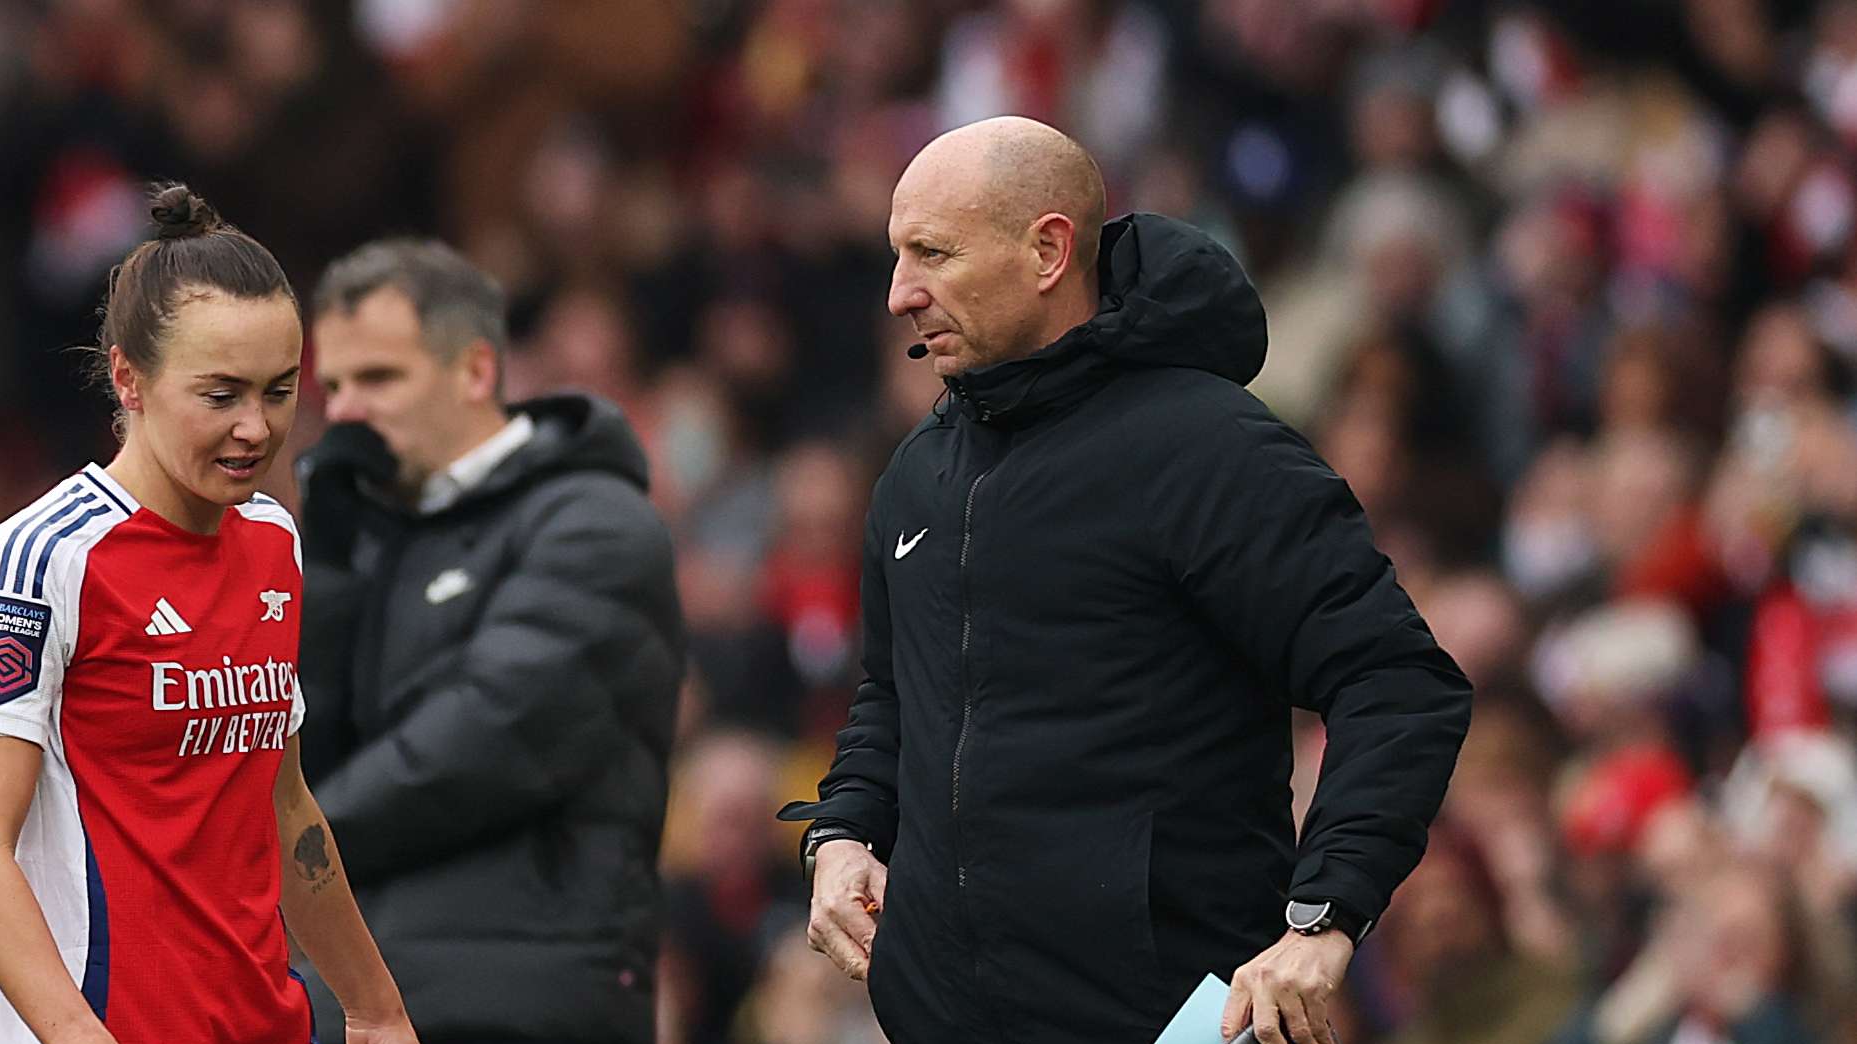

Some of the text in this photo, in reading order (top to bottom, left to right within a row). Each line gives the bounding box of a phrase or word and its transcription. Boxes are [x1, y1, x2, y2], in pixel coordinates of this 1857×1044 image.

[10, 626, 40, 638] LEAGUE
[151, 655, 294, 711] Emirates
[178, 710, 288, 757] FLY BETTER
